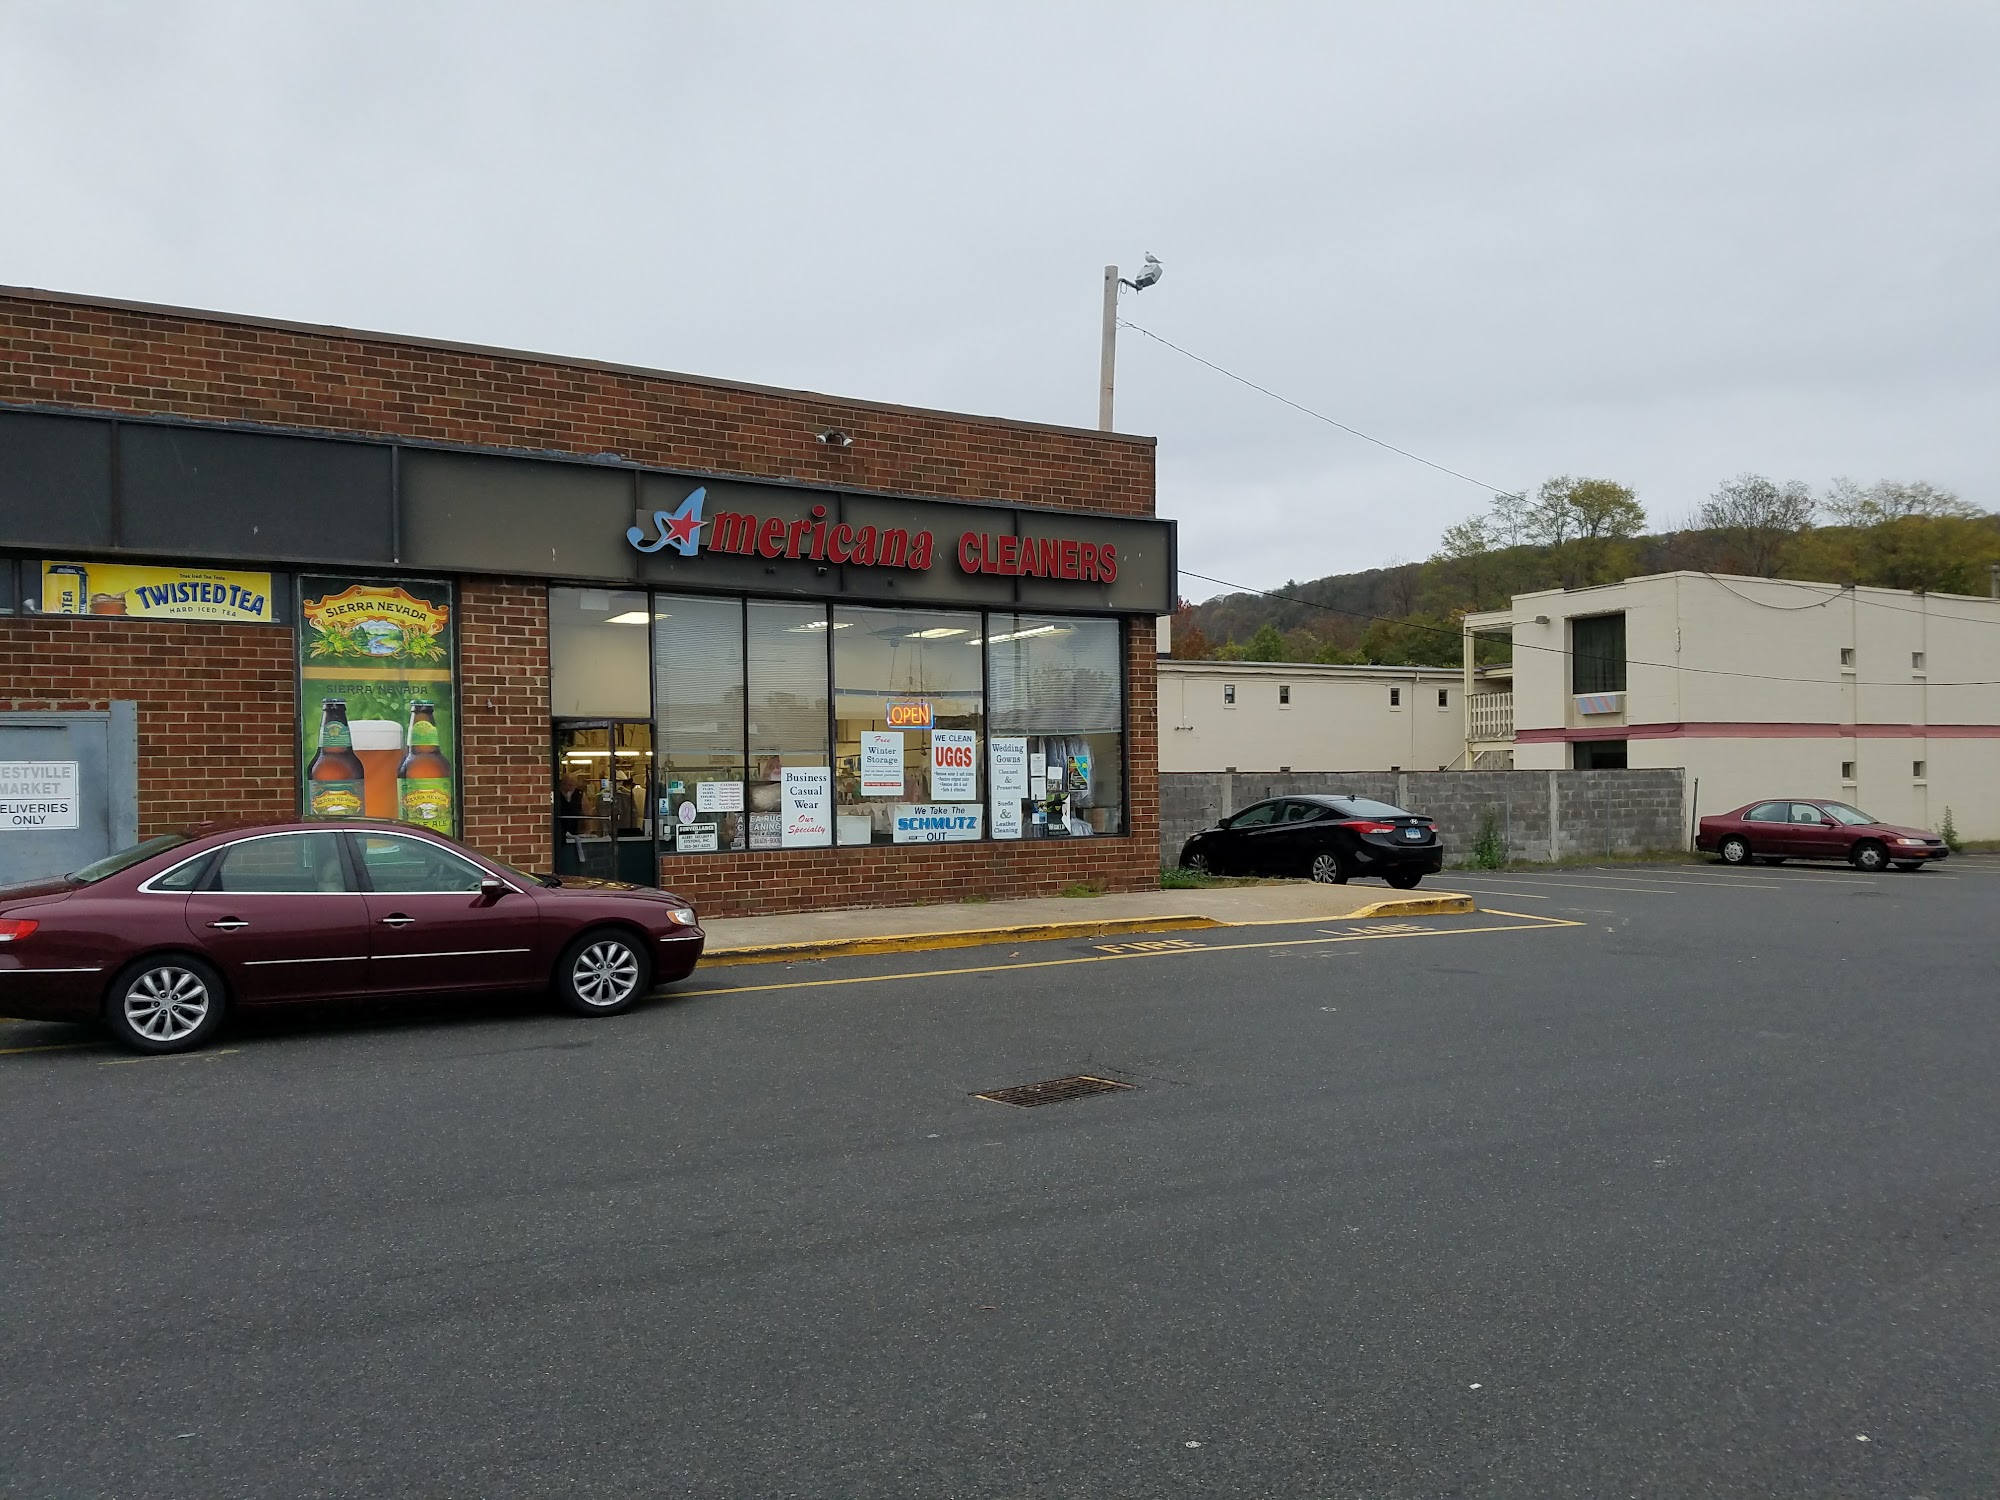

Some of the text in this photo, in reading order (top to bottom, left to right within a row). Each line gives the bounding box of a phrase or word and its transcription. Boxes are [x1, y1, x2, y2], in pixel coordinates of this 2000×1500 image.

[626, 486, 1118, 583] Americana CLEANERS
[62, 590, 73, 608] TEA
[134, 582, 265, 616] TWISTED TEA
[169, 606, 237, 617] HARD ICED TEA
[325, 601, 428, 622] SIERRA NEVADA
[326, 685, 428, 695] SIERRA NEVADA
[891, 703, 929, 724] OPEN
[874, 735, 891, 743] Free
[934, 734, 973, 742] WE CLEAN
[867, 746, 897, 755] Winter
[991, 743, 1024, 755] Wedding
[866, 755, 898, 766] Storage
[935, 746, 973, 768] UGGS
[996, 754, 1021, 763] Gowns
[0, 766, 71, 779] ESTVILLE
[786, 772, 827, 782] Business
[1004, 775, 1013, 784] &
[0, 782, 61, 795] MARKET
[789, 785, 823, 796] Casual
[0, 803, 69, 814] ELIVERIES
[794, 799, 819, 809] Wear
[914, 806, 966, 815] We Take The
[999, 808, 1012, 820] &
[12, 815, 47, 825] ONLY
[764, 814, 781, 822] RUG
[798, 814, 814, 823] Our
[897, 816, 978, 831] SCHMUTZ
[787, 824, 826, 835] Specialty
[926, 832, 948, 841] OUT
[1316, 923, 1437, 936] LANE
[1092, 939, 1208, 954] FIRE
